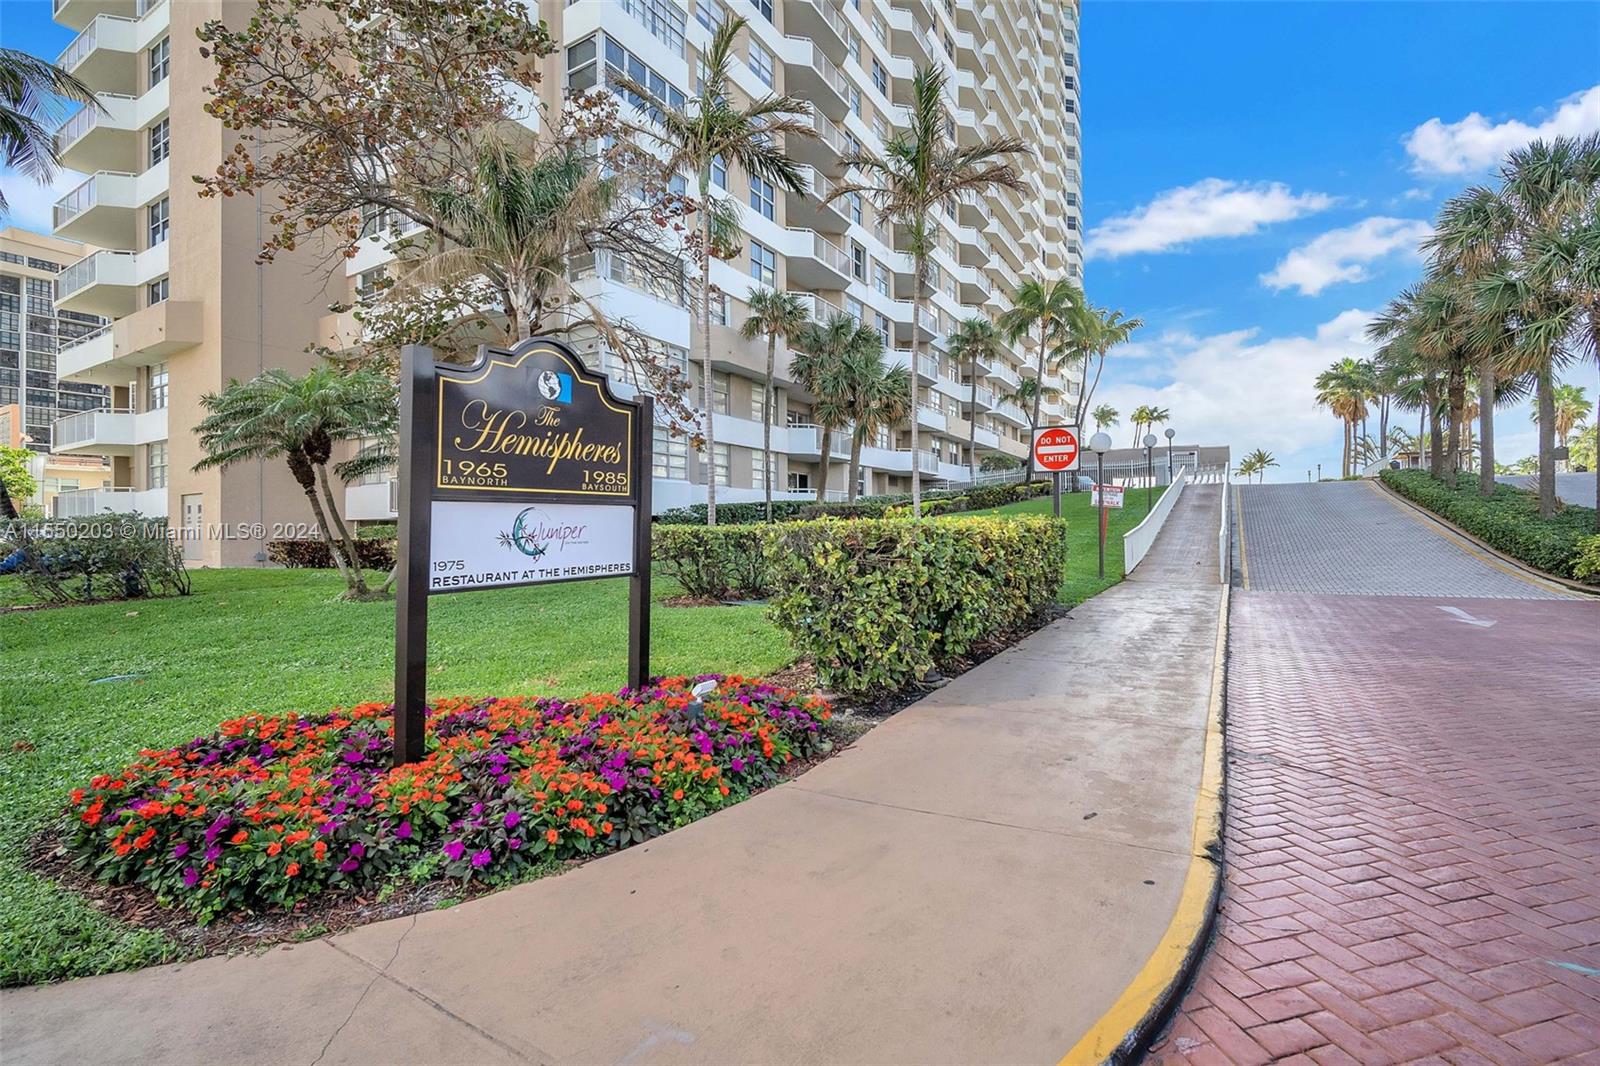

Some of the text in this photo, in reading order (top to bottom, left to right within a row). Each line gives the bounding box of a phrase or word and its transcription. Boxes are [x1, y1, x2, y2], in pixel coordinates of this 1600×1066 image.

[534, 405, 561, 427] The
[454, 399, 622, 475] Hemispheres
[443, 459, 508, 478] 1965
[583, 470, 627, 484] 1985
[442, 476, 508, 487] BAYNORTH
[582, 483, 628, 492] BAYSOUTH
[536, 521, 587, 552] Juniper
[432, 560, 466, 572] 1975
[432, 562, 631, 587] RESTAURANT AT THE HEMISPHERES
